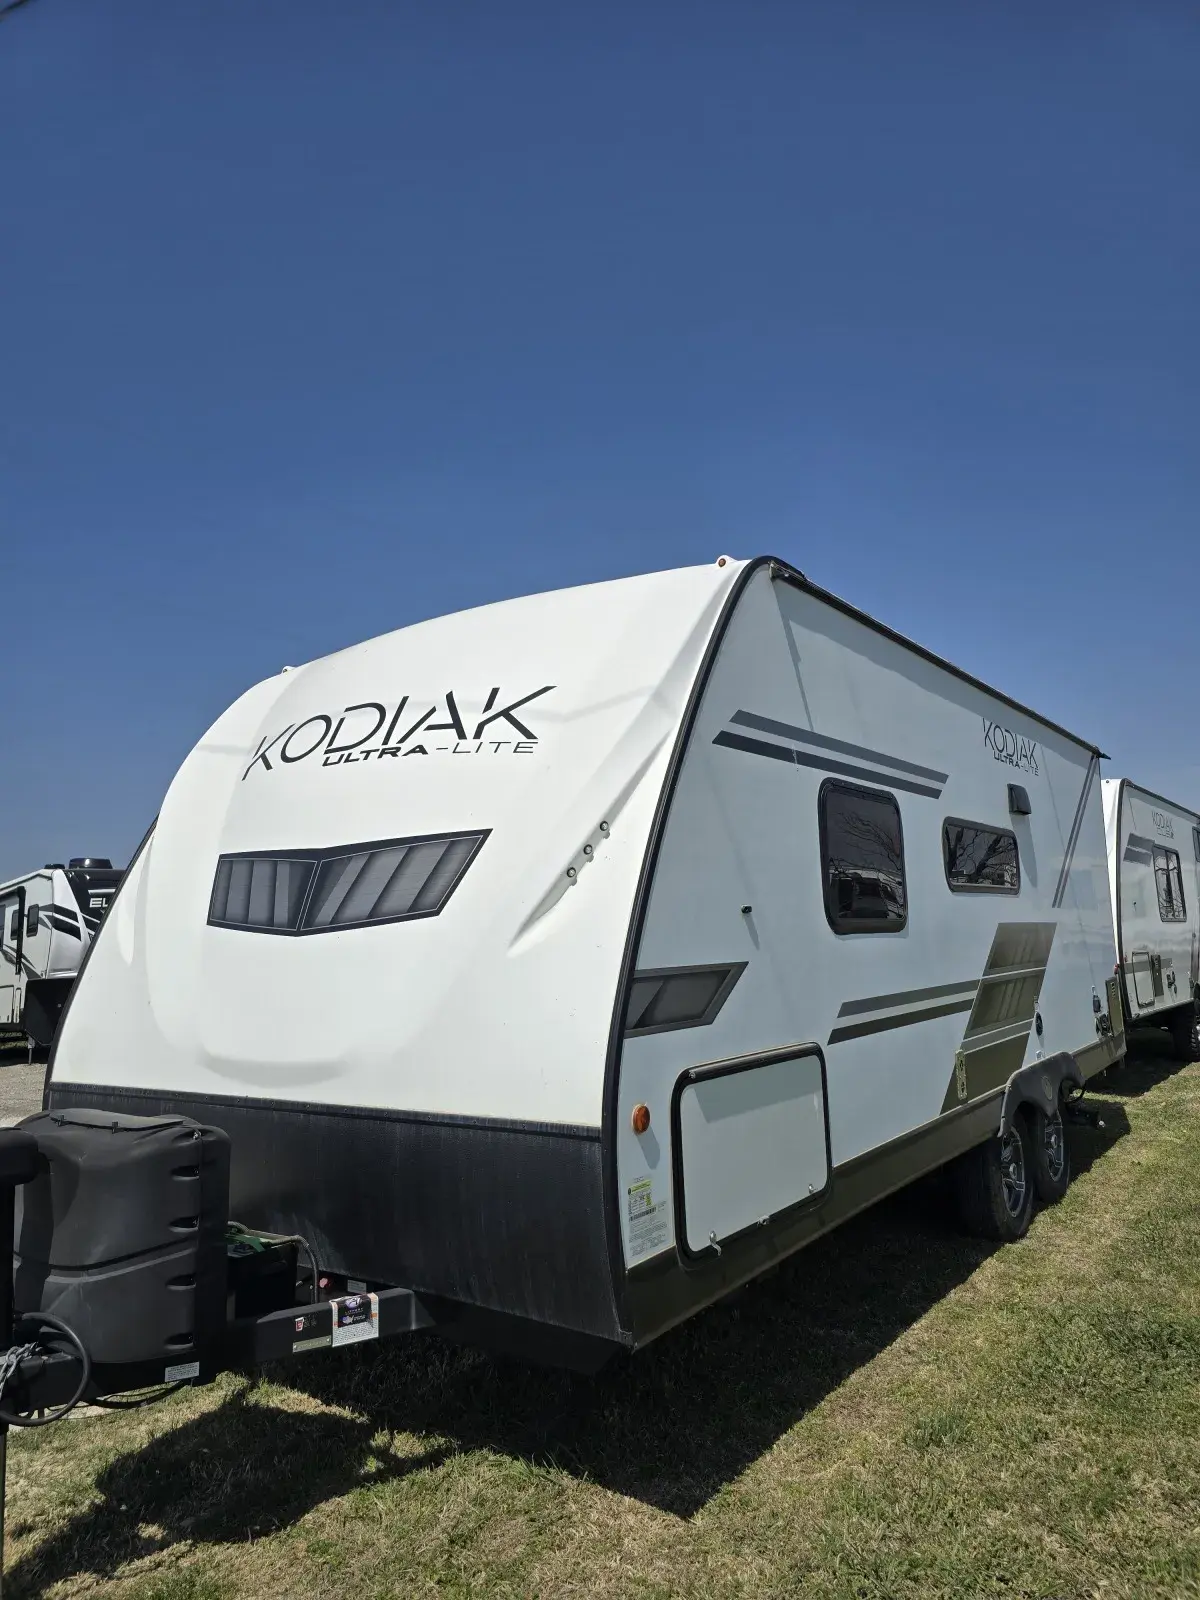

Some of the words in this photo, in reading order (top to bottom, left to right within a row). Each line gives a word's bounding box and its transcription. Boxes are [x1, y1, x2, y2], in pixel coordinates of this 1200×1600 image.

[241, 685, 557, 781] KODIAK
[322, 741, 538, 767] ULTRA-LITE
[982, 717, 1039, 769] KODIAK
